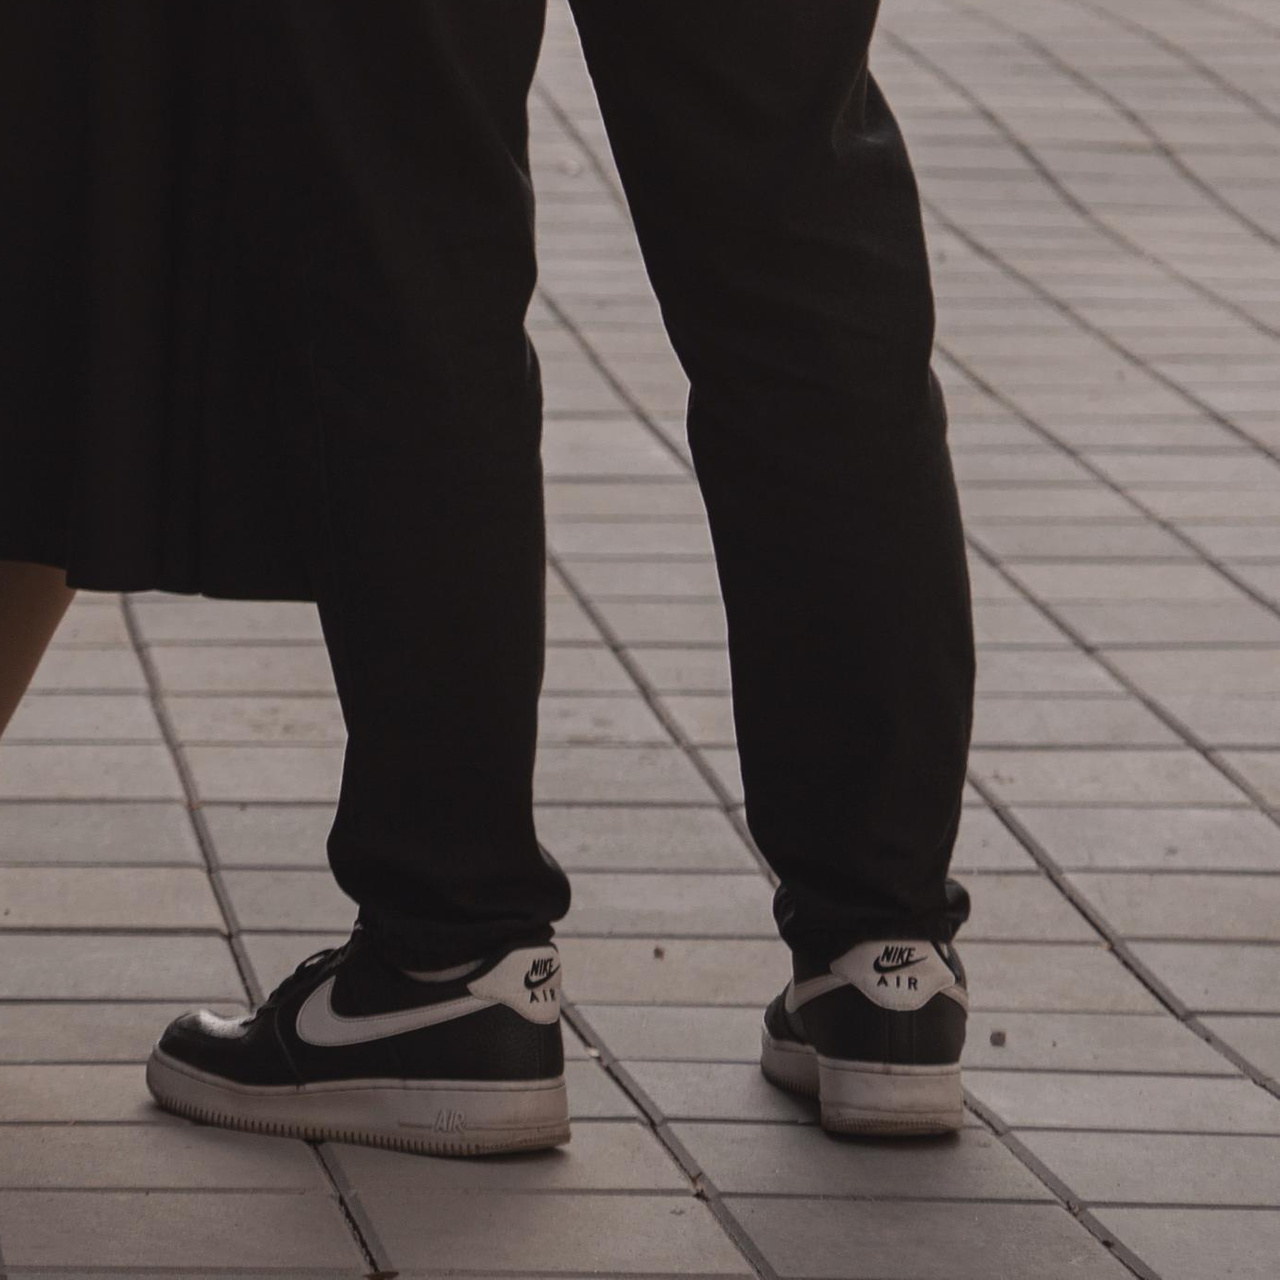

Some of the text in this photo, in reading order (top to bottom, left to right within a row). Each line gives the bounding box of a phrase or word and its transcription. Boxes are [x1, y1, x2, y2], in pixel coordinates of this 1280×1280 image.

[881, 946, 915, 964] NIKE
[530, 958, 553, 977] NIKE
[877, 976, 917, 990] AIR
[530, 989, 556, 1003] AIR
[434, 1109, 466, 1132] AIR
